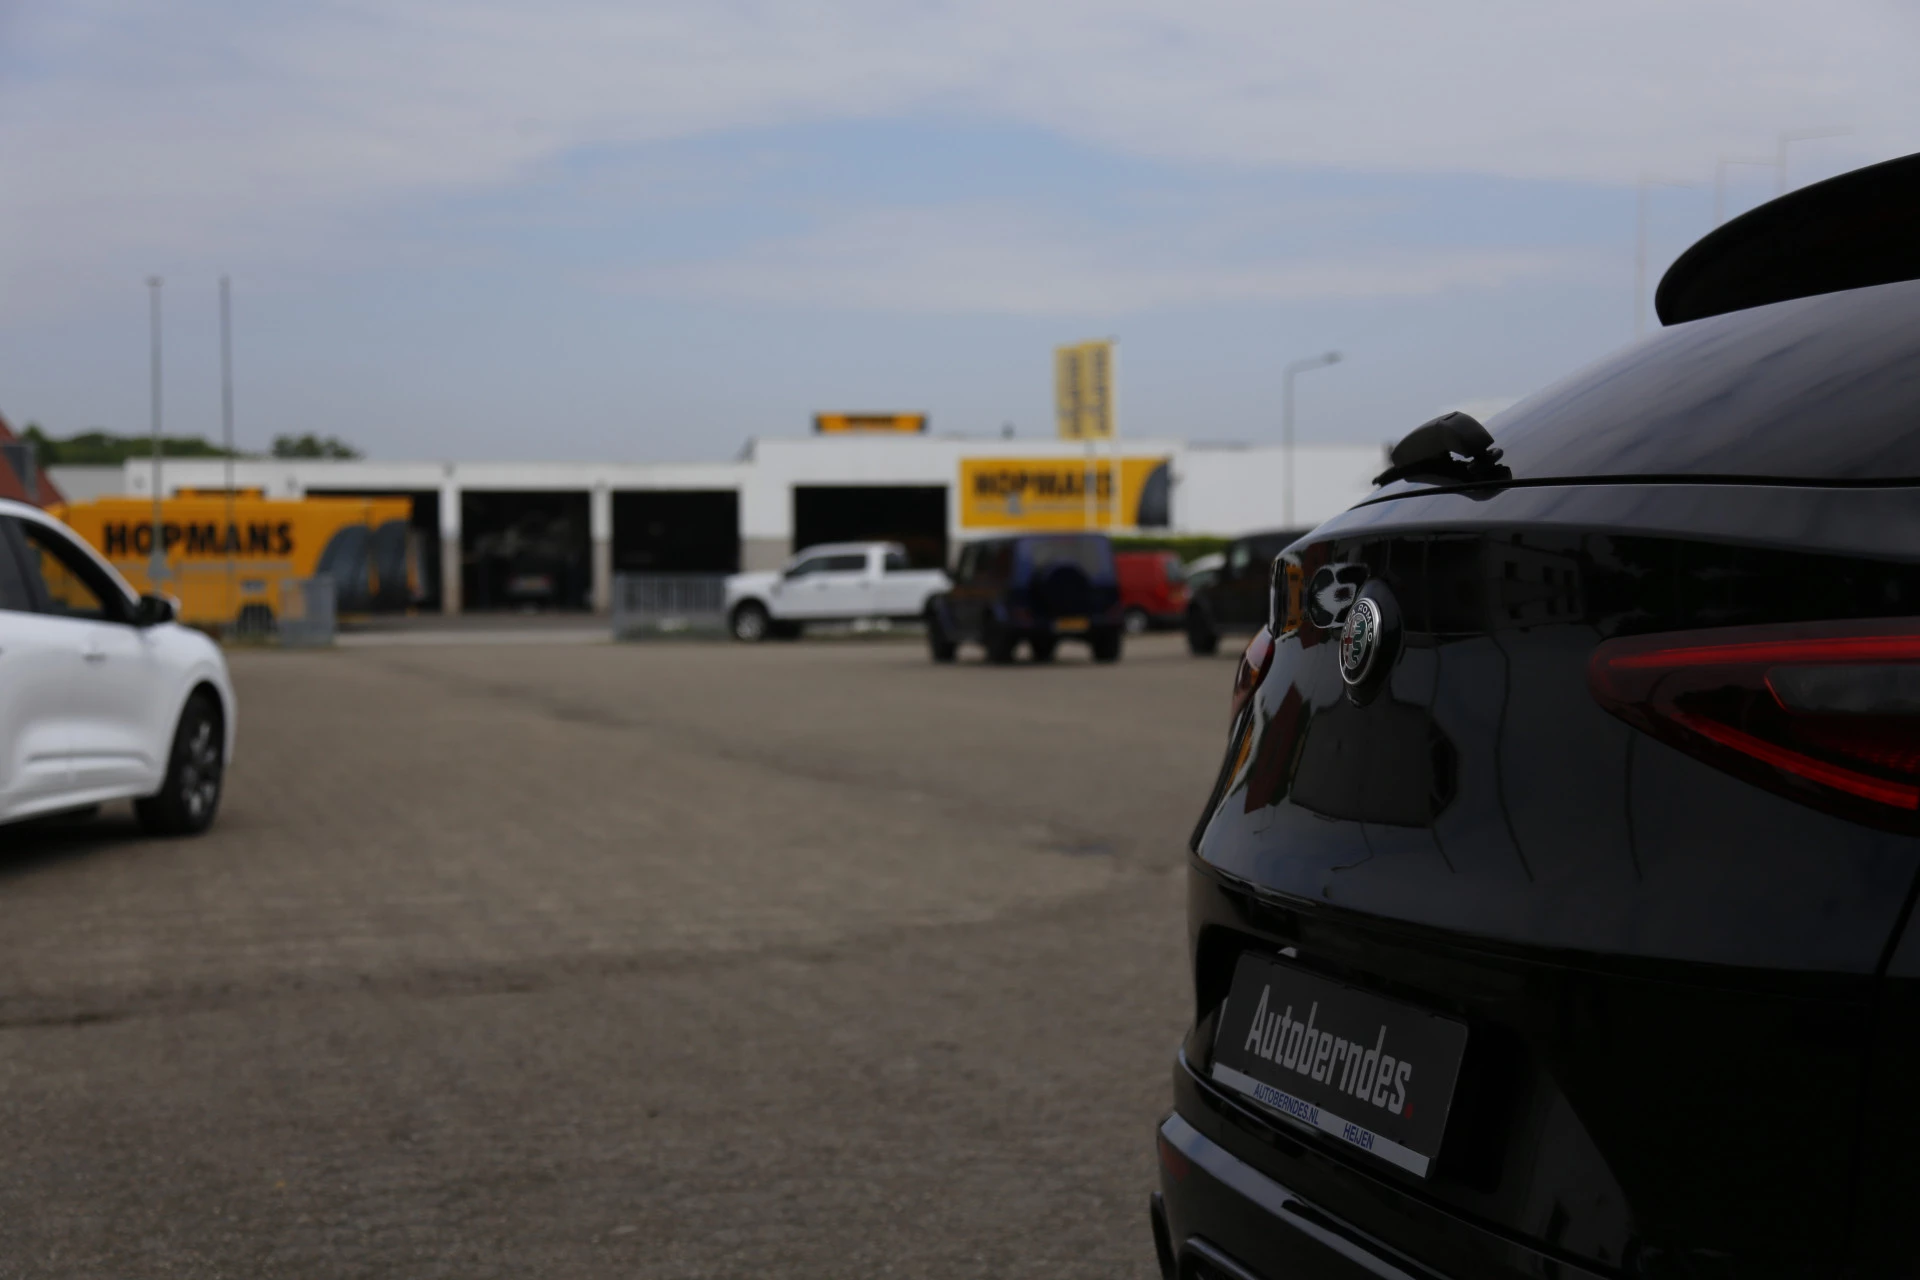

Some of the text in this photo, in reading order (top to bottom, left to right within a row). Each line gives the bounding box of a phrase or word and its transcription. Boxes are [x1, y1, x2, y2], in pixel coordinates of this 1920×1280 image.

[104, 521, 294, 556] HOPMANS
[1358, 604, 1373, 642] ROMEO
[1253, 1084, 1375, 1150] AUTOBERNDES.NL HEIJEN
